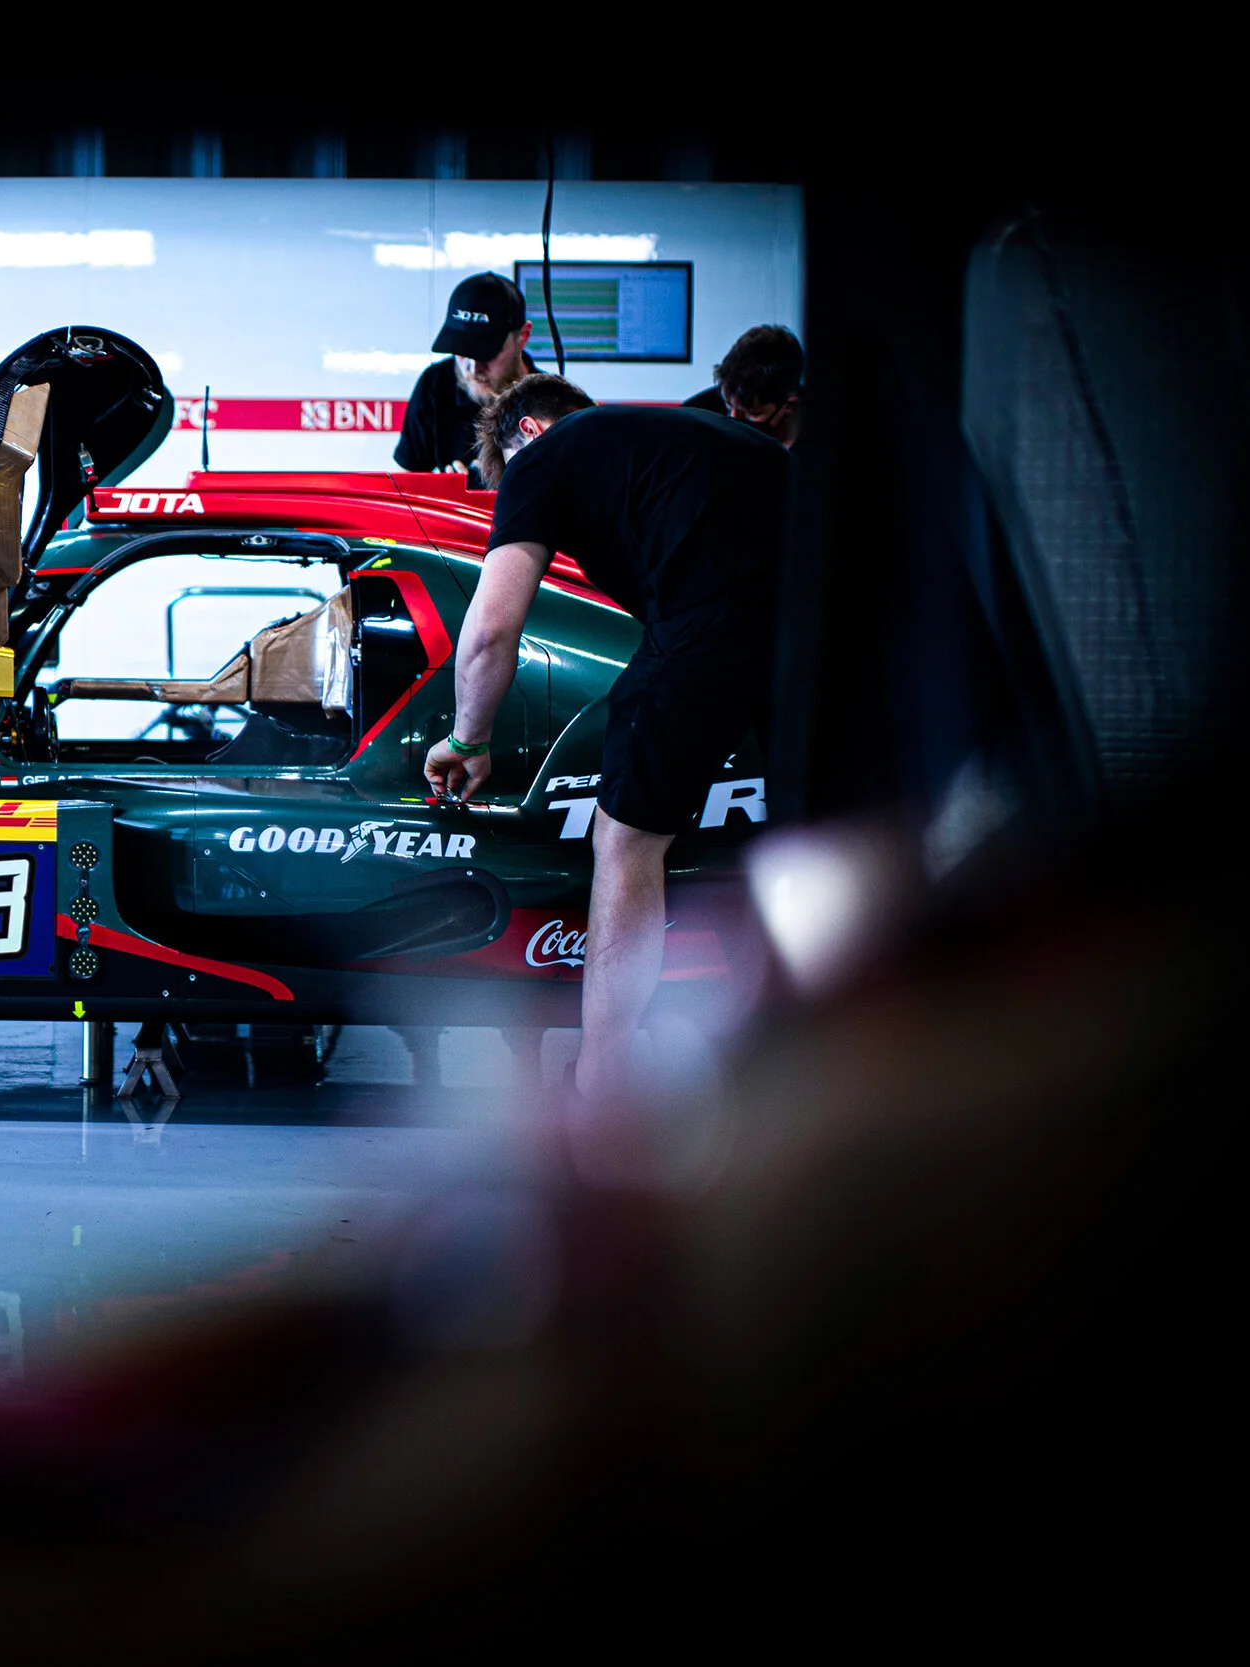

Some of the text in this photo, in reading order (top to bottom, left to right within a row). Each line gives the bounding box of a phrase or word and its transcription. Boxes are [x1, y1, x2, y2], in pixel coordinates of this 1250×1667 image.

[452, 309, 490, 323] JOTA
[333, 400, 393, 430] BNI
[98, 493, 205, 514] JOTA
